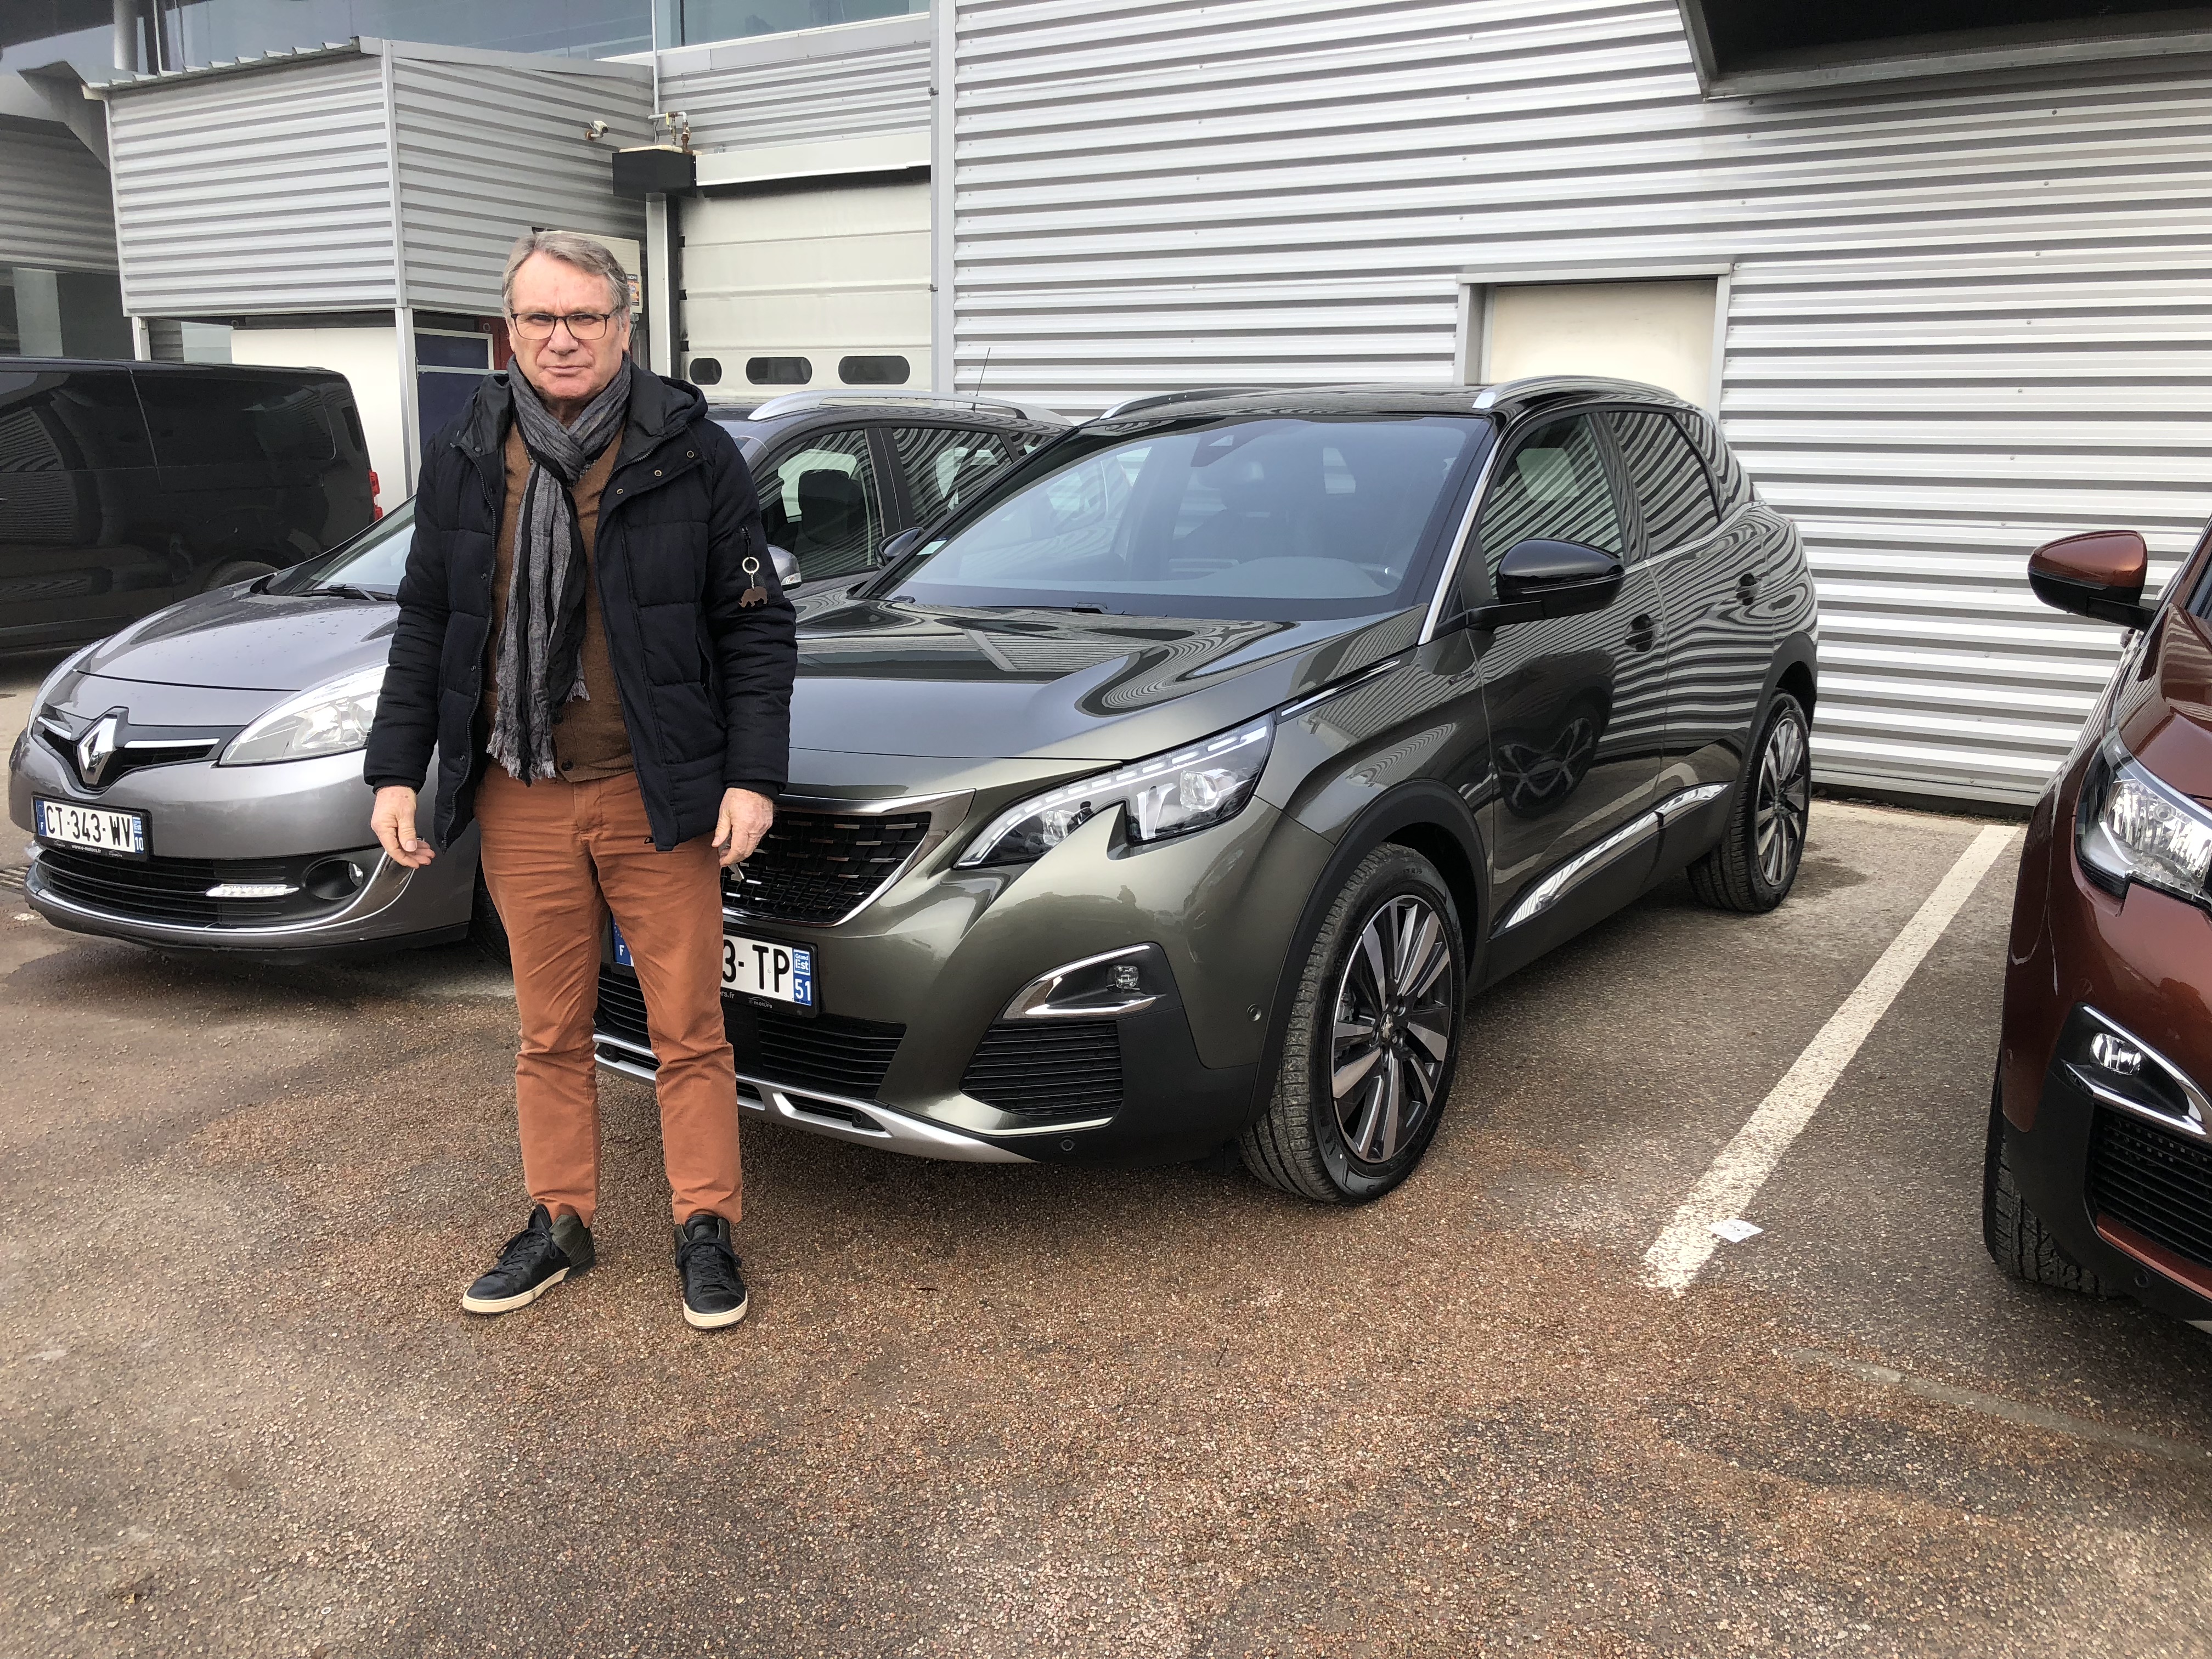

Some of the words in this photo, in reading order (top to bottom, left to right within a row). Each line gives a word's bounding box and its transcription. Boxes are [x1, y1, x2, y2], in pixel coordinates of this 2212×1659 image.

[40, 821, 44, 830] F
[46, 805, 130, 848] CT-343-WV
[134, 837, 144, 851] 10
[618, 944, 625, 956] F
[723, 939, 790, 993] 3-TP
[795, 958, 809, 970] Est
[795, 978, 811, 1001] 51
